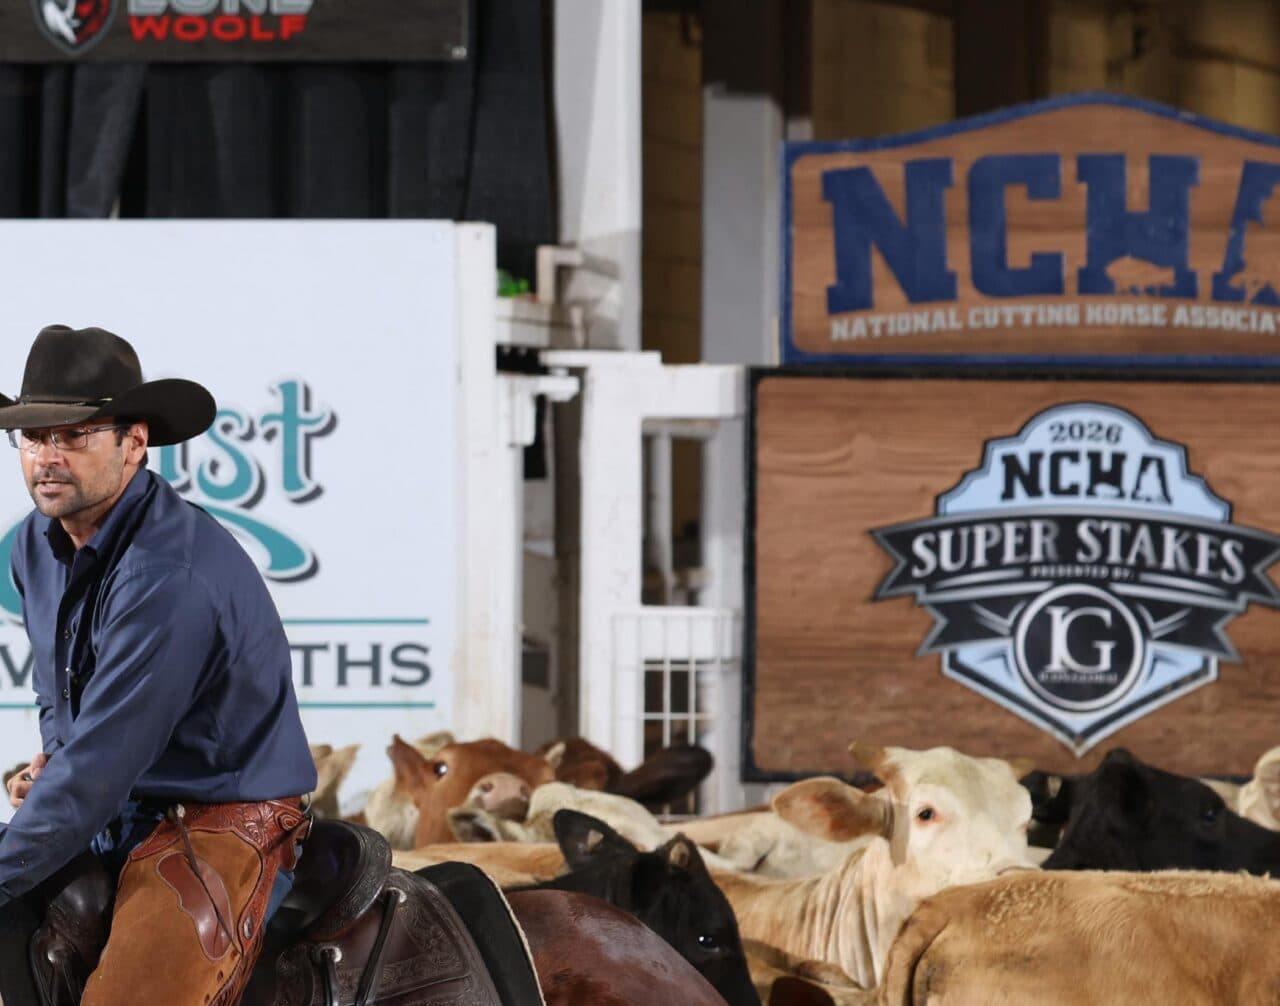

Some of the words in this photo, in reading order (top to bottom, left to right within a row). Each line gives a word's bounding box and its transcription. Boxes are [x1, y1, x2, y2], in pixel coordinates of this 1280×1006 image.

[129, 14, 307, 41] WOOLF
[831, 306, 963, 341] NATIONAL
[968, 303, 1080, 329] CUTTING
[1085, 303, 1168, 327] HORSE
[1173, 303, 1280, 335] ASSOCIA
[1049, 421, 1123, 445] 2026
[1000, 450, 1173, 506] NCHA
[912, 519, 1060, 580] SUPER
[1075, 519, 1245, 585] STAKES
